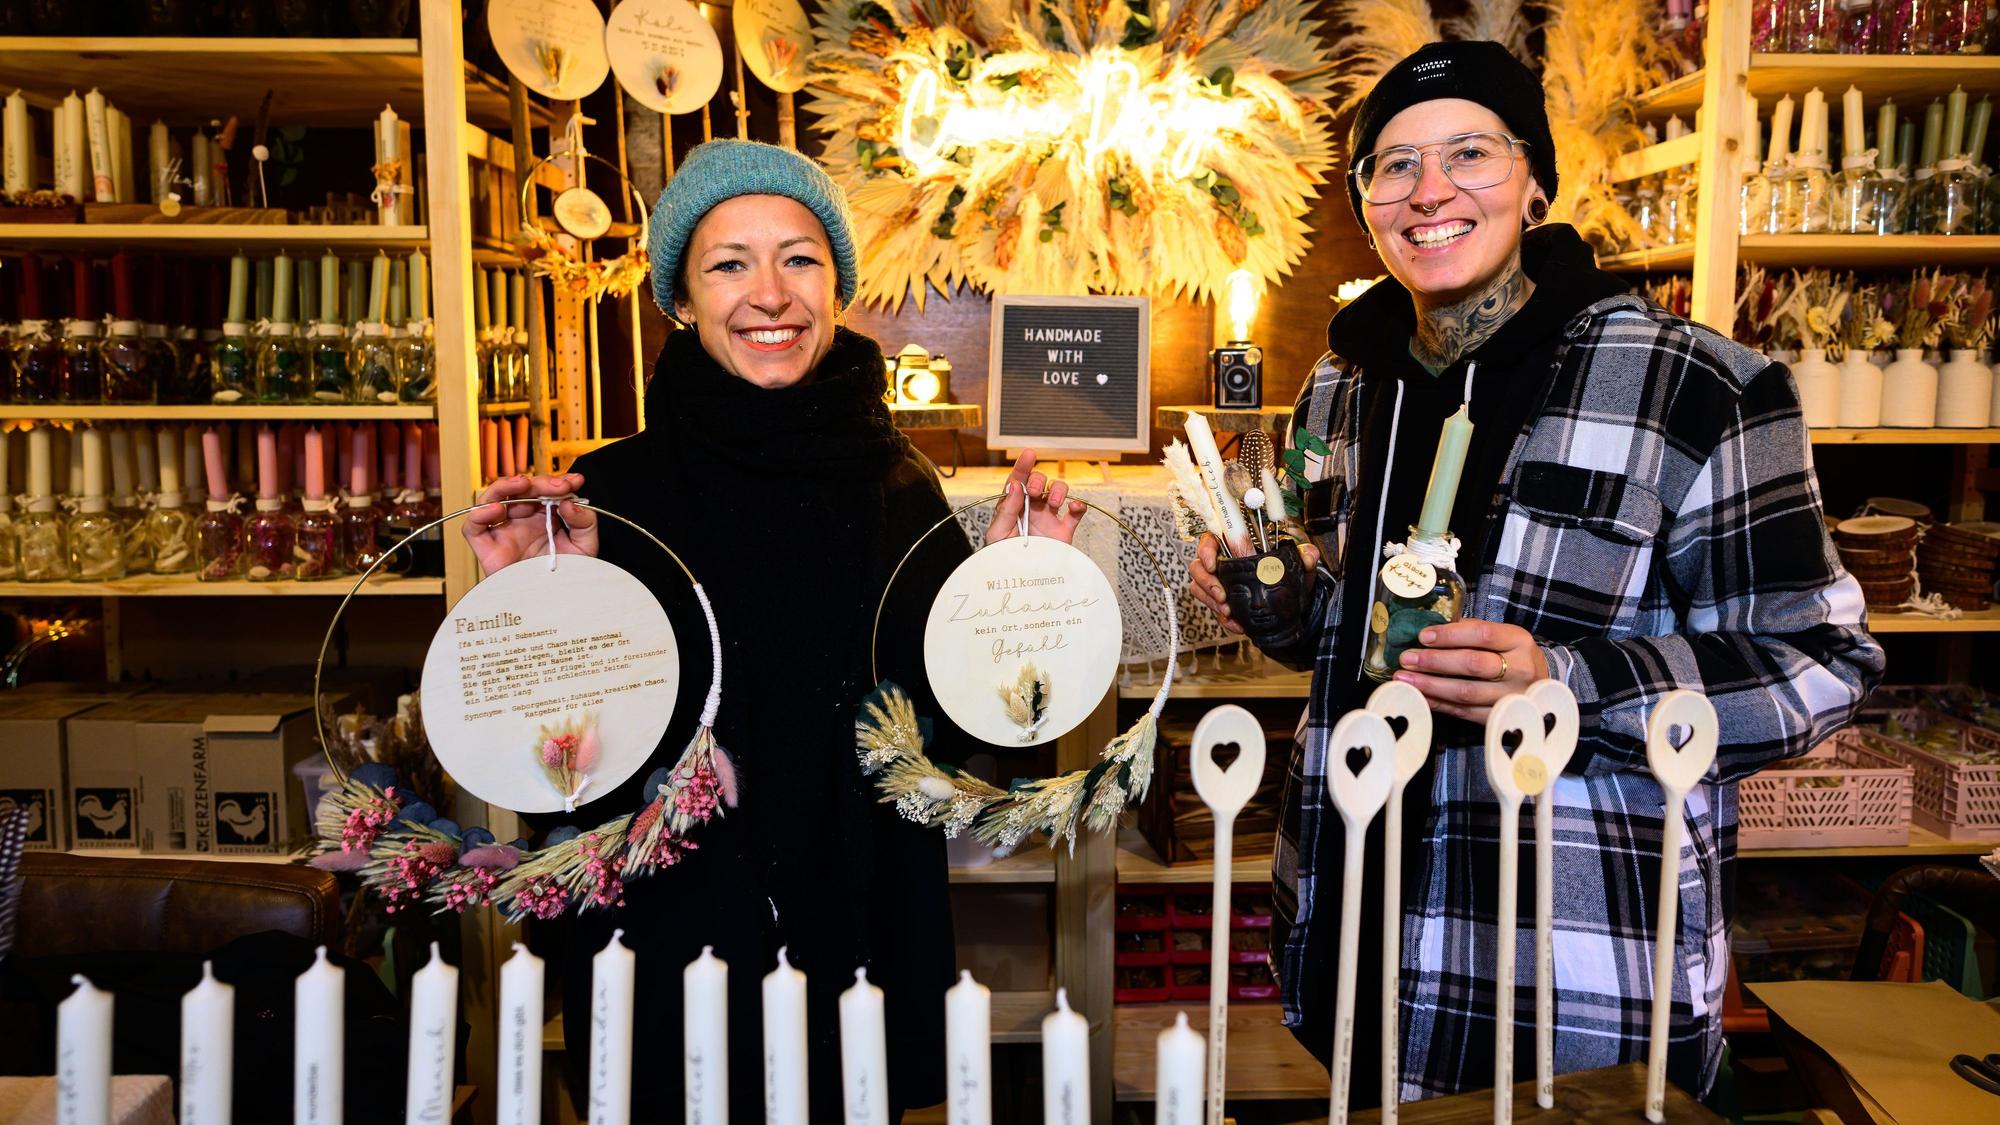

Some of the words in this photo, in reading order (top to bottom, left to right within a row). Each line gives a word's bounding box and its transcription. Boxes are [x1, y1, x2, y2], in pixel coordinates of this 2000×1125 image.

[1024, 328, 1102, 343] HANDMADE
[1048, 350, 1083, 364] WITH
[1043, 371, 1080, 386] LOVE
[986, 575, 1065, 591] Willkommen
[947, 592, 1099, 623] Zuhause
[975, 626, 997, 635] kein
[1066, 617, 1082, 626] ein
[483, 651, 501, 659] wenn
[504, 647, 527, 656] Liebe
[531, 644, 544, 652] und
[546, 640, 568, 649] Chaos
[572, 636, 588, 645] hier
[592, 632, 623, 642] manchmal
[559, 646, 586, 656] bleibt
[602, 641, 615, 649] der
[992, 634, 1069, 664] Gefühl
[608, 656, 620, 664] ist
[477, 670, 492, 678] dem
[526, 678, 540, 687] und
[465, 698, 481, 706] ein
[484, 692, 510, 702] Leben
[193, 736, 209, 841] KERZENFARM
